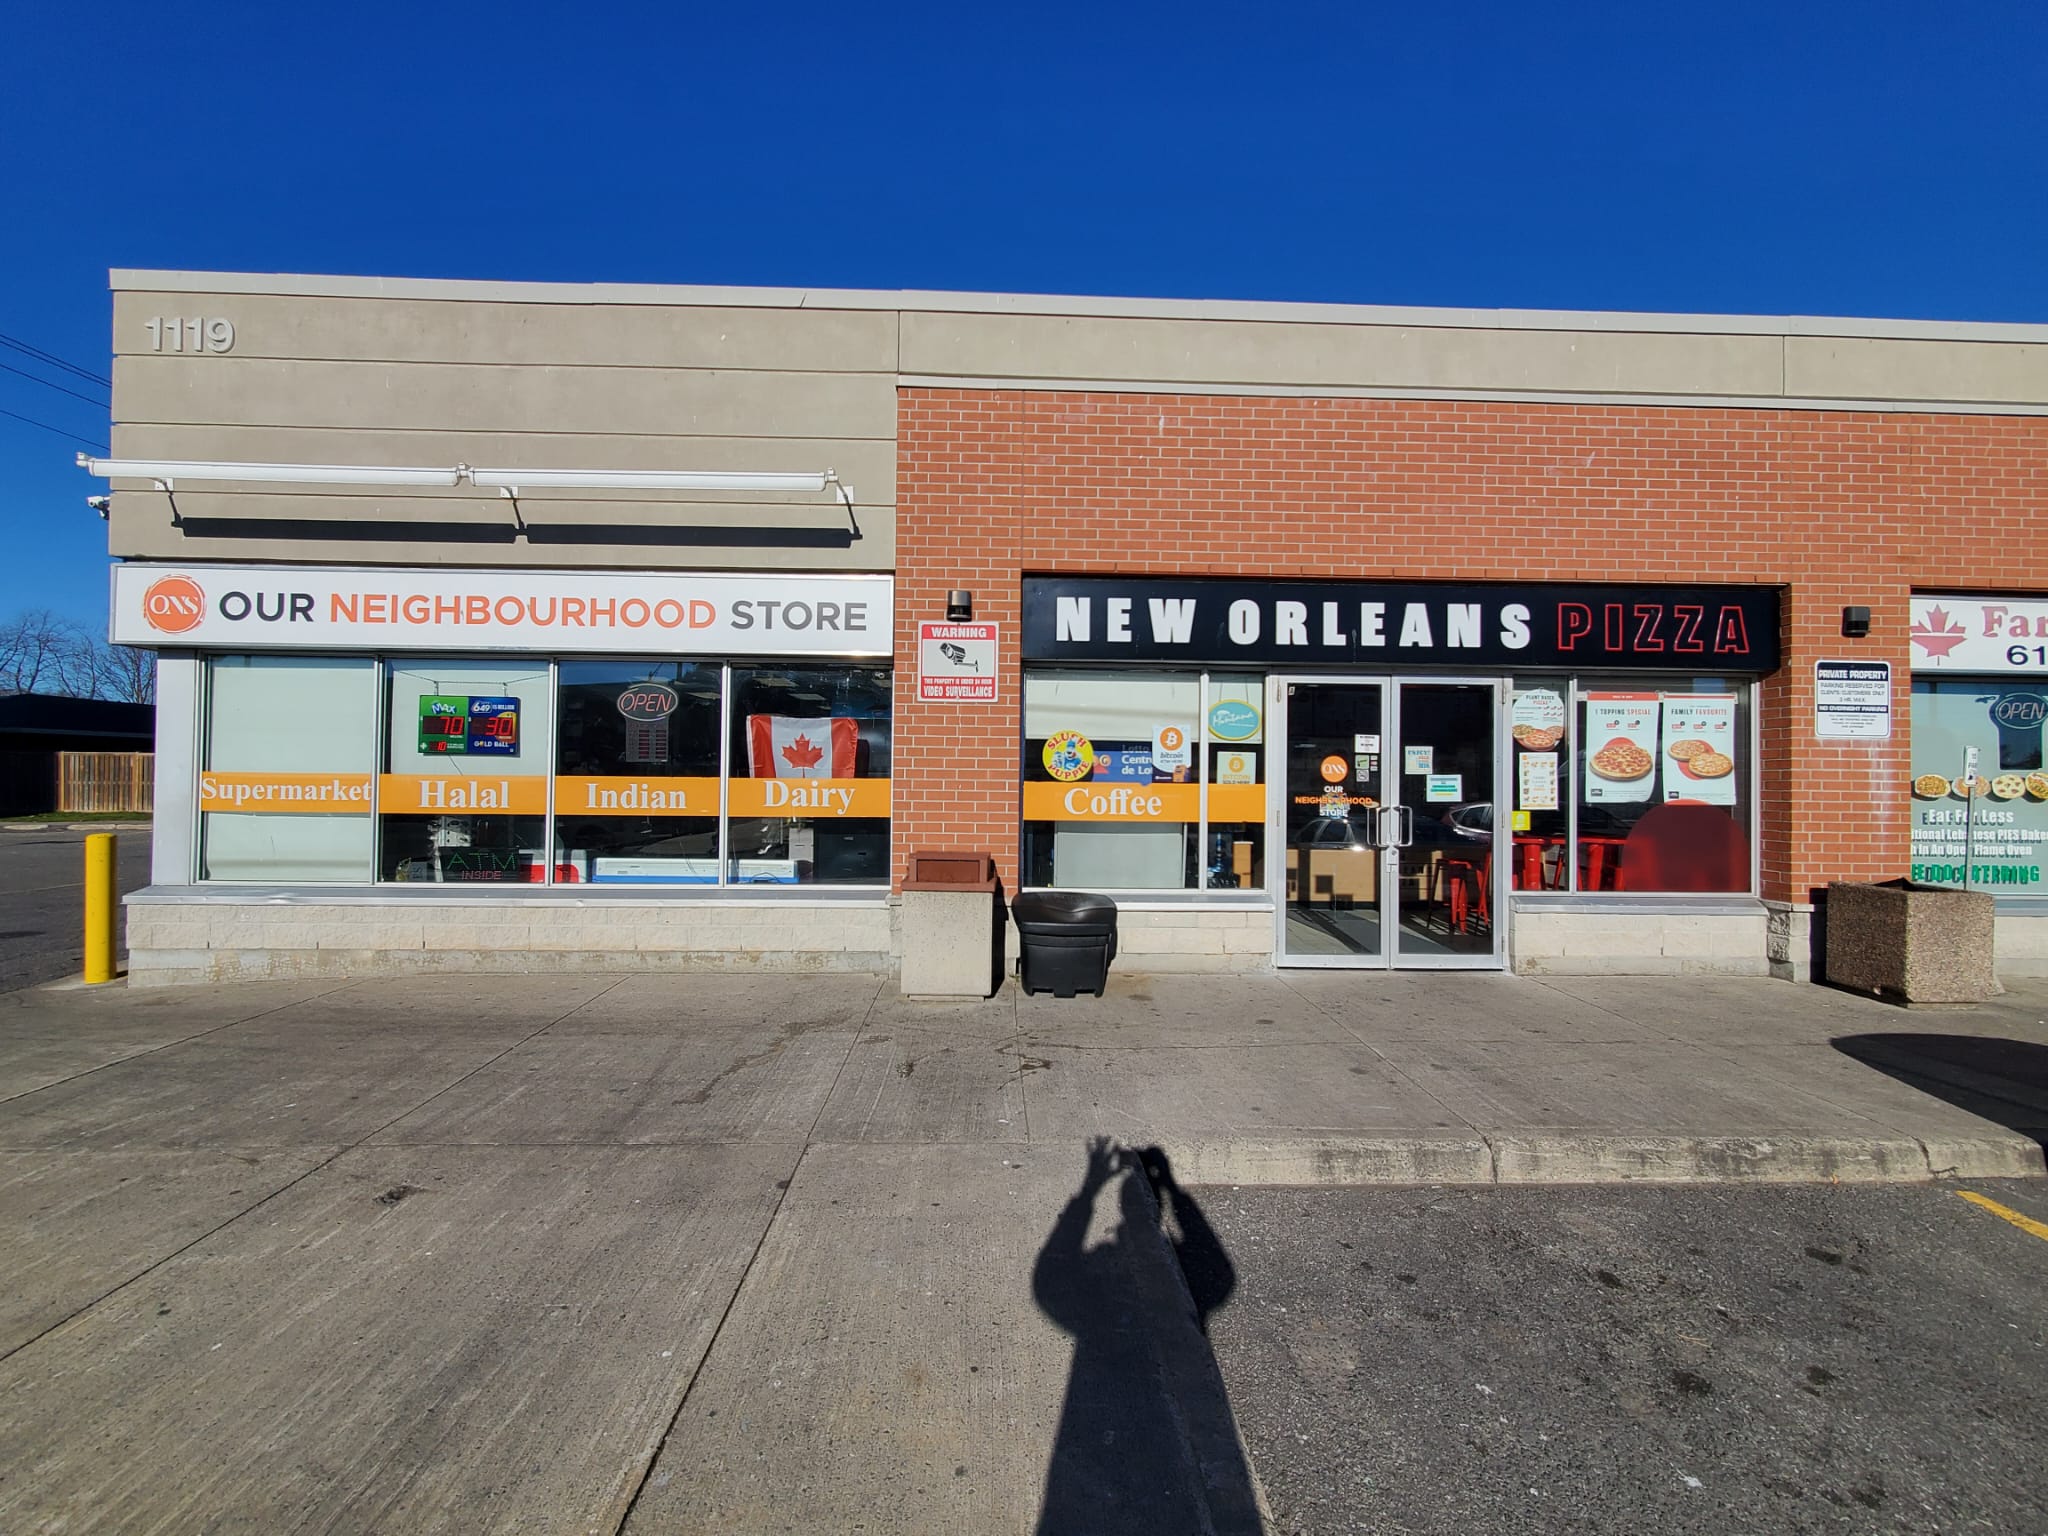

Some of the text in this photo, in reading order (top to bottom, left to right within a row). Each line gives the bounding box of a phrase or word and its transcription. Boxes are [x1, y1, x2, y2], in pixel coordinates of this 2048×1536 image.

[144, 316, 236, 354] 1119
[218, 591, 868, 632] OUR NEIGHBOURHOOD STORE
[931, 626, 987, 638] WARNING
[1055, 597, 1750, 653] NEW ORLEANS PIZZA
[1818, 669, 1887, 680] PRIVATE PROPERTY
[924, 685, 993, 697] VIDEO SURVEILLANCE
[431, 702, 457, 714] MAX
[472, 701, 492, 713] 649
[620, 693, 673, 712] OPEN
[1998, 702, 2045, 720] OPEN
[440, 716, 465, 735] 70
[485, 717, 513, 736] 30
[1121, 743, 1150, 754] Lotto
[1121, 754, 1152, 765] Centr
[1047, 760, 1091, 780] PUPPIE
[1121, 765, 1152, 775] de Lo
[201, 776, 373, 806] Supermarket
[418, 779, 511, 809] Halal
[586, 783, 688, 810] Indian
[763, 780, 856, 815] Dairy
[1323, 785, 1344, 793] OUR
[1064, 787, 1163, 817] Coffee
[1928, 809, 1952, 823] Eat
[1982, 809, 2015, 824] Less
[1946, 828, 1996, 841] Lebese
[1997, 828, 2021, 841] PIES
[1930, 844, 1944, 855] An
[1946, 844, 1967, 857] Ope
[1974, 845, 2006, 856] Flame
[2006, 845, 2033, 857] Oven
[446, 851, 517, 871] ATM
[461, 870, 504, 881] INSIDE
